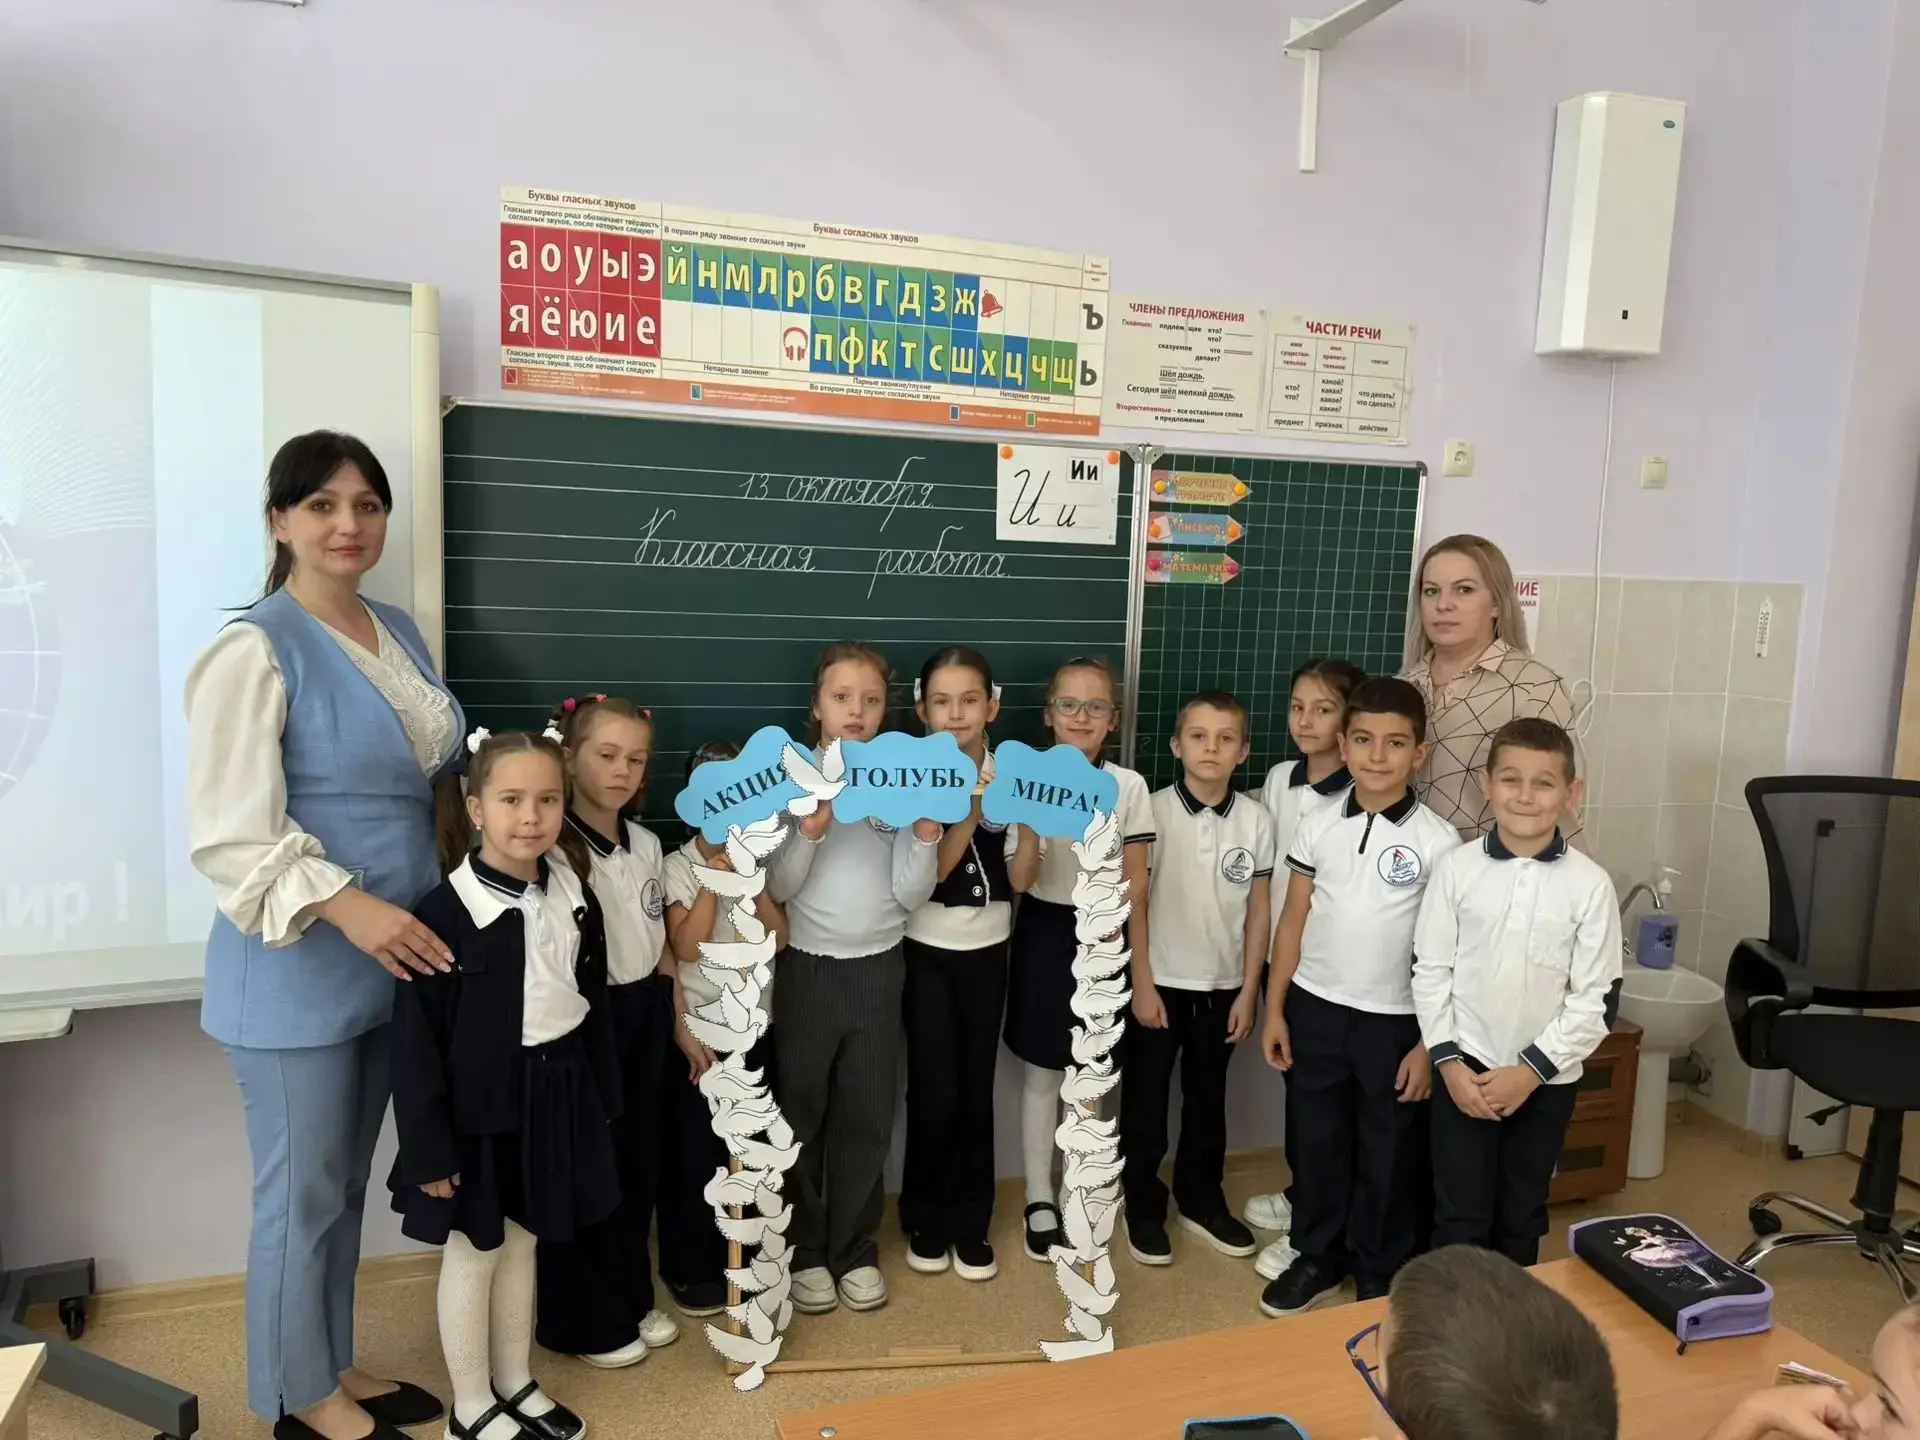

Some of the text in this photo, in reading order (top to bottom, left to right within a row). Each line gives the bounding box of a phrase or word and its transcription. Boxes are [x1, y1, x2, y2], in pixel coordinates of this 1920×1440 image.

[528, 189, 636, 211] Буквы гласных звуков
[503, 205, 532, 214] Гласные
[534, 208, 562, 219] первого
[564, 212, 582, 221] ряда
[583, 213, 624, 224] обозначают
[508, 213, 544, 222] согласных
[595, 222, 624, 231] которых
[625, 225, 655, 235] следуют
[671, 229, 698, 238] первом
[700, 231, 717, 241] ряду
[719, 233, 747, 243] звонкие
[749, 236, 785, 247] согласные
[786, 240, 806, 250] звуки
[813, 223, 919, 244] Буквы согласных звуков
[508, 240, 656, 285] а о у ы э
[667, 245, 976, 317] й н м л р б в г д з ж
[508, 296, 656, 345] я ё ю и е
[1129, 302, 1245, 322] ЧЛЕНЫ ПРЕДЛОЖЕНИЯ
[1306, 321, 1382, 340] ЧАСТИ РЕЧИ
[506, 349, 535, 358] Гласные
[537, 352, 565, 361] второго
[585, 356, 625, 365] обозначают
[1158, 343, 1192, 352] сказуемое
[509, 357, 545, 366] согласных
[574, 362, 593, 370] после
[595, 364, 624, 373] которых
[625, 366, 655, 376] следуют
[814, 326, 1073, 391] п ф к т с ш х ц ч щ
[703, 364, 769, 377] Непарные звонкие
[1160, 369, 1205, 381] Шёл дождь.
[852, 377, 932, 391] Парные звонкие/глухие
[1126, 383, 1159, 394] Сегодня
[1160, 387, 1177, 395] шёл
[1178, 388, 1207, 397] мелкий
[1207, 391, 1236, 400] дождь.
[1321, 378, 1344, 386] какой?
[1321, 387, 1343, 395] какая?
[820, 385, 844, 394] втором
[845, 387, 862, 397] ряду
[863, 388, 886, 397] глухие
[887, 390, 921, 399] согласные
[922, 392, 941, 401] звуки
[999, 390, 1030, 400] Непарные
[1284, 393, 1300, 401] что?
[1188, 409, 1224, 417] остальные
[1368, 401, 1396, 409] сделать?
[1274, 419, 1304, 427] предмет
[1358, 425, 1388, 433] действие
[739, 472, 769, 501] 13
[634, 507, 816, 573] Классная
[850, 766, 966, 789] ГОЛУБЬ
[1012, 777, 1100, 815] МИРА!
[0, 881, 91, 941] ир
